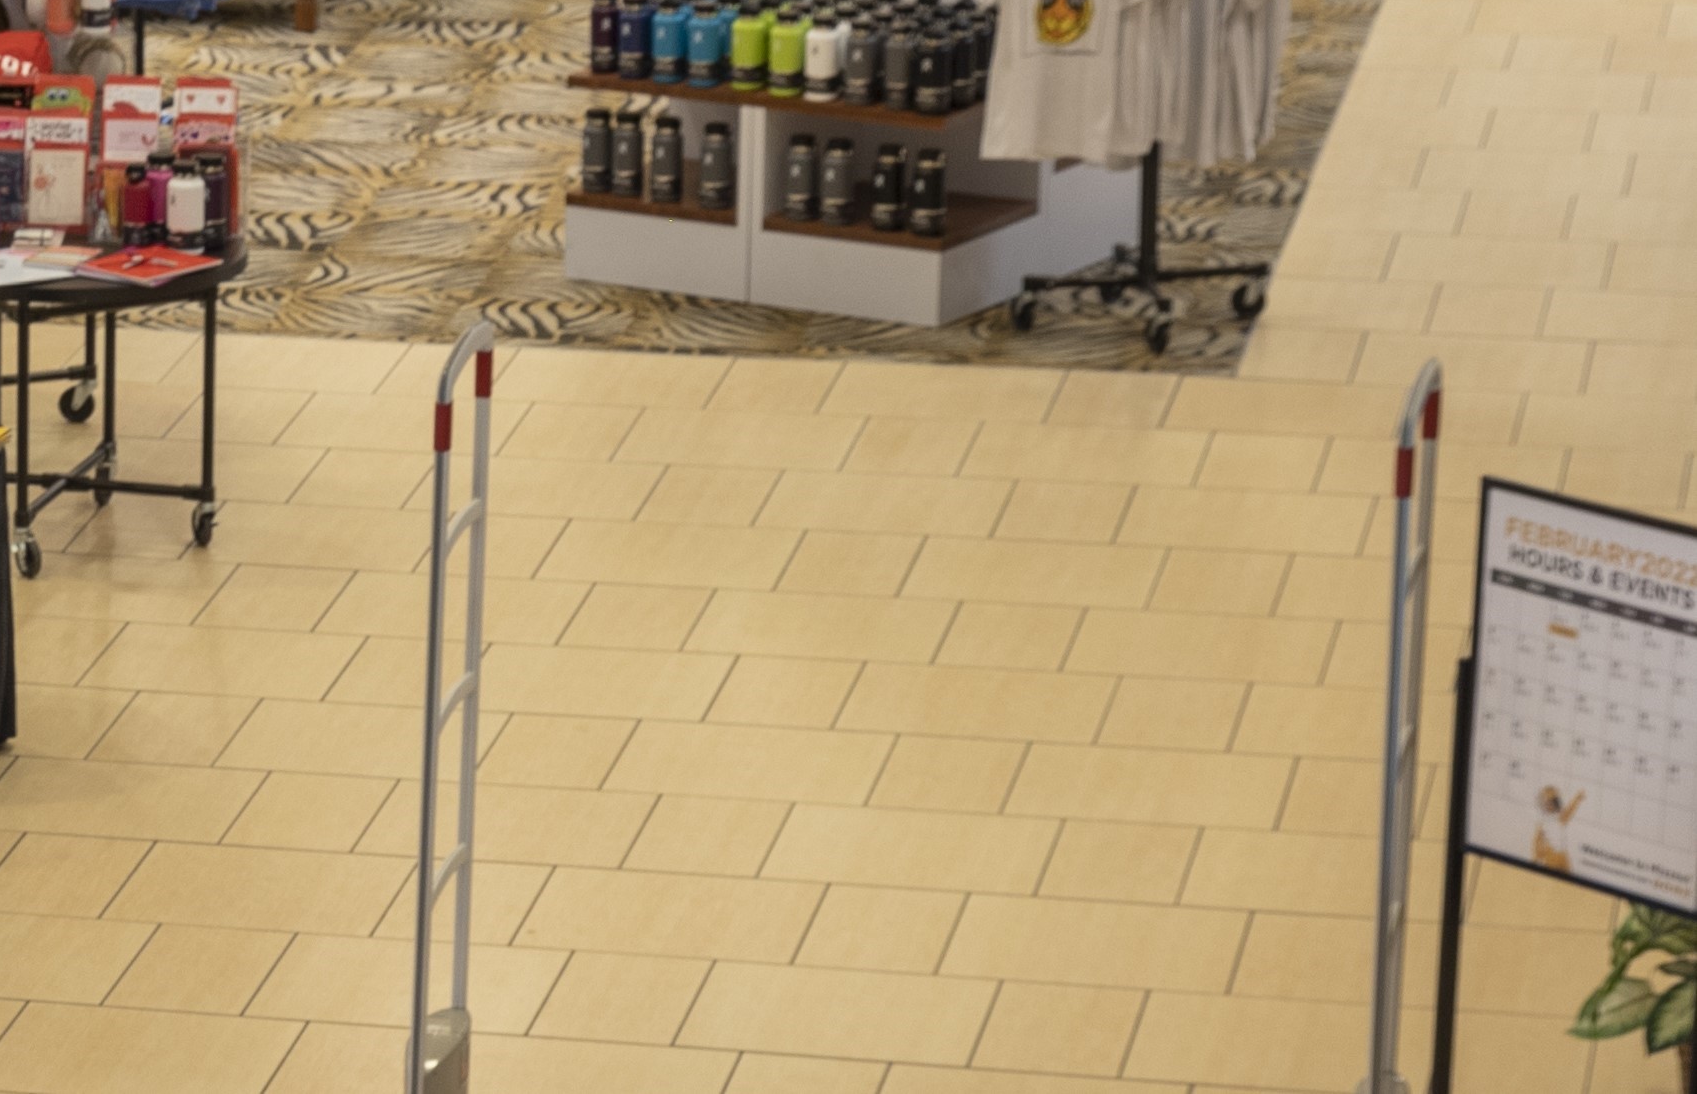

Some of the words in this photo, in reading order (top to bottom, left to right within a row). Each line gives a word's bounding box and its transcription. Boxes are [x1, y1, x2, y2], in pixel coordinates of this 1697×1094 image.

[1509, 543, 1584, 581] HOURS
[1588, 564, 1604, 585] &
[1609, 569, 1696, 611] EVENTS
